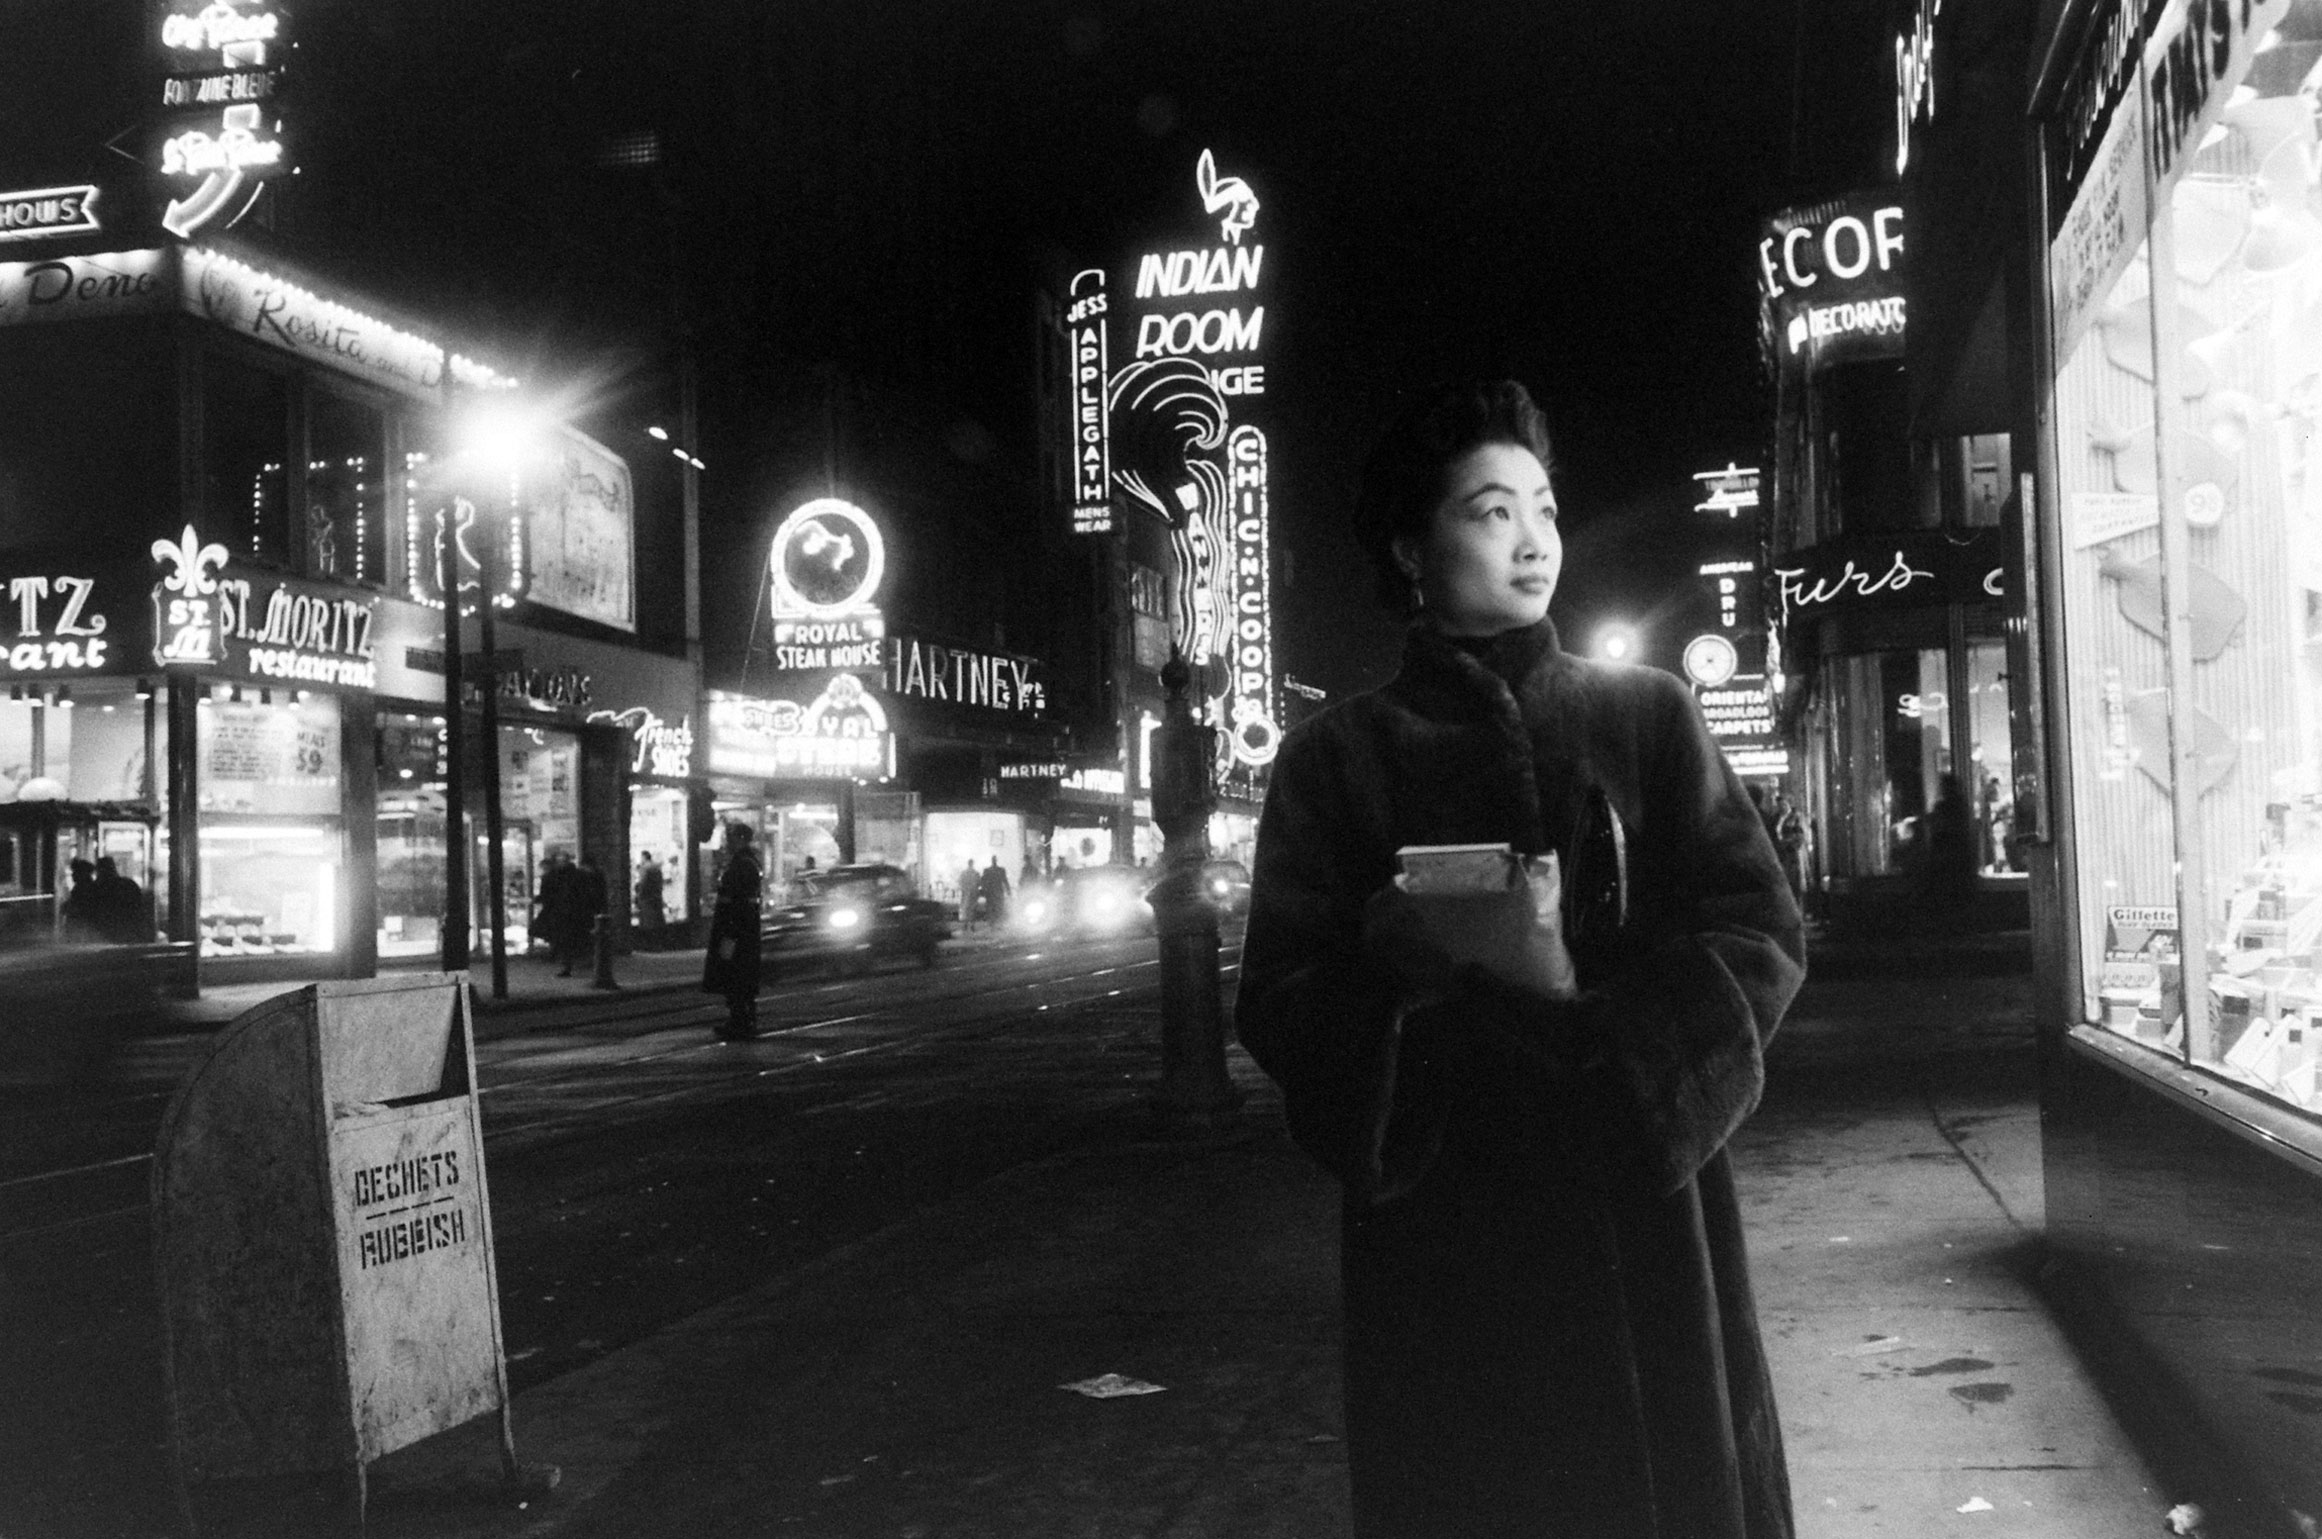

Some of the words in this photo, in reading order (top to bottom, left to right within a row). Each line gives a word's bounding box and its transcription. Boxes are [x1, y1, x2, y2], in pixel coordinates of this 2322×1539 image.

[1136, 245, 1263, 298] INDIAN
[253, 292, 368, 366] Rosita
[1067, 293, 1107, 323] JESS
[1136, 306, 1264, 358] ROOM
[1080, 327, 1102, 500] APPLEGATH
[1073, 519, 1112, 533] WEAR
[9, 576, 107, 637] TZ
[1774, 551, 1934, 628] Furs
[257, 588, 374, 661] MORITZ
[796, 623, 863, 645] ROYAL
[9, 638, 108, 671] ant
[249, 648, 376, 689] restaurant
[776, 645, 826, 670] STEAK
[830, 640, 881, 668] HOUSE
[1000, 763, 1067, 778] HARTNEY
[2113, 908, 2176, 921] Gillette
[355, 1151, 460, 1207] DECHETS
[360, 1209, 466, 1270] RUBBISH
